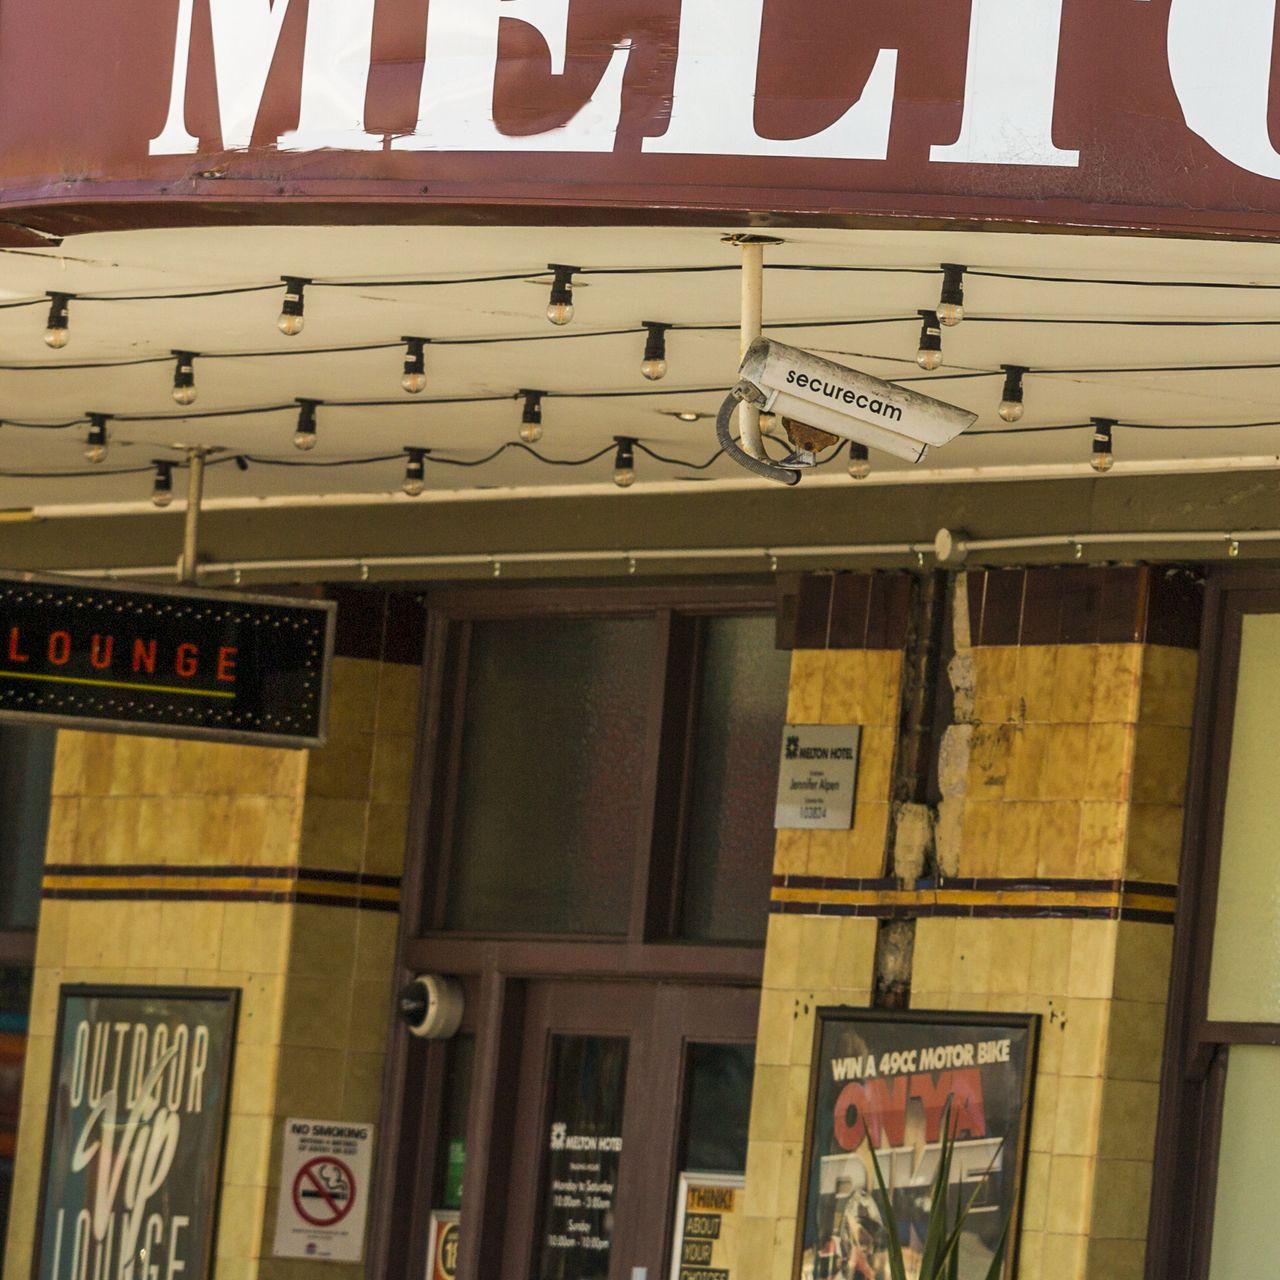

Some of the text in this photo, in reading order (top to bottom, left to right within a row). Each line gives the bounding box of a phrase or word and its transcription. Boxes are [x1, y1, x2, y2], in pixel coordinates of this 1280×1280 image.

[786, 369, 902, 421] securecam
[8, 627, 238, 682] LOUNGE
[70, 1020, 209, 1112] OUTDOOR
[832, 1039, 1011, 1081] WIN A 49CC MOTOR BIKE
[292, 1123, 367, 1140] NO SMOKING
